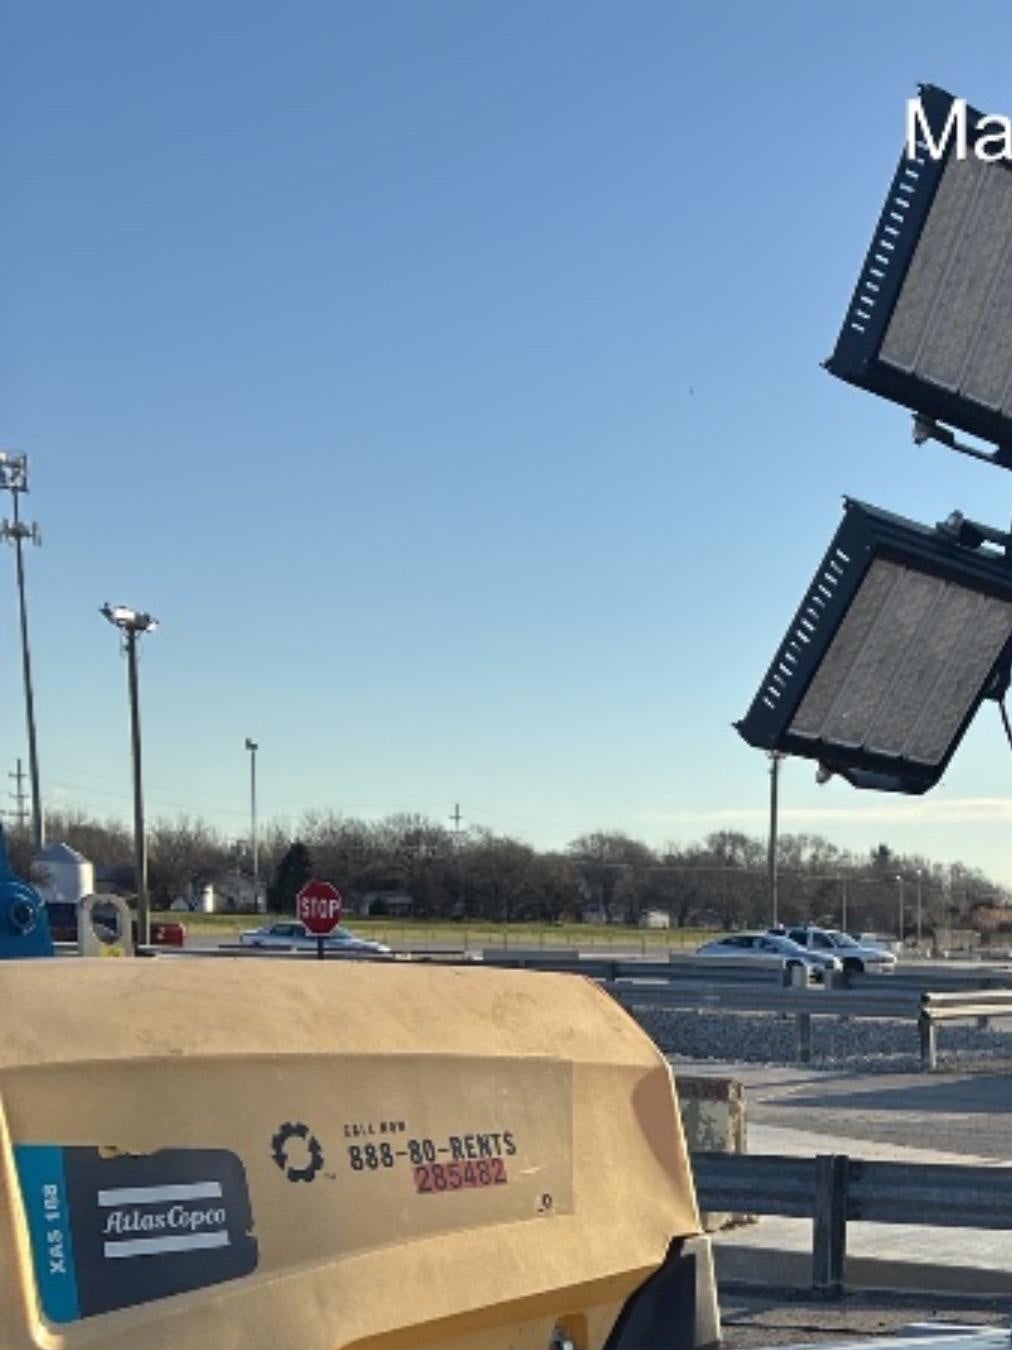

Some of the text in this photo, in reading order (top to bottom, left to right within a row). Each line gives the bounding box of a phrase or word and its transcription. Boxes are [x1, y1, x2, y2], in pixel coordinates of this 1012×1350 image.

[301, 897, 340, 919] STOP
[349, 1131, 517, 1171] 888-80-RENTS
[415, 1158, 508, 1194] 285482
[47, 1229, 66, 1274] XAS
